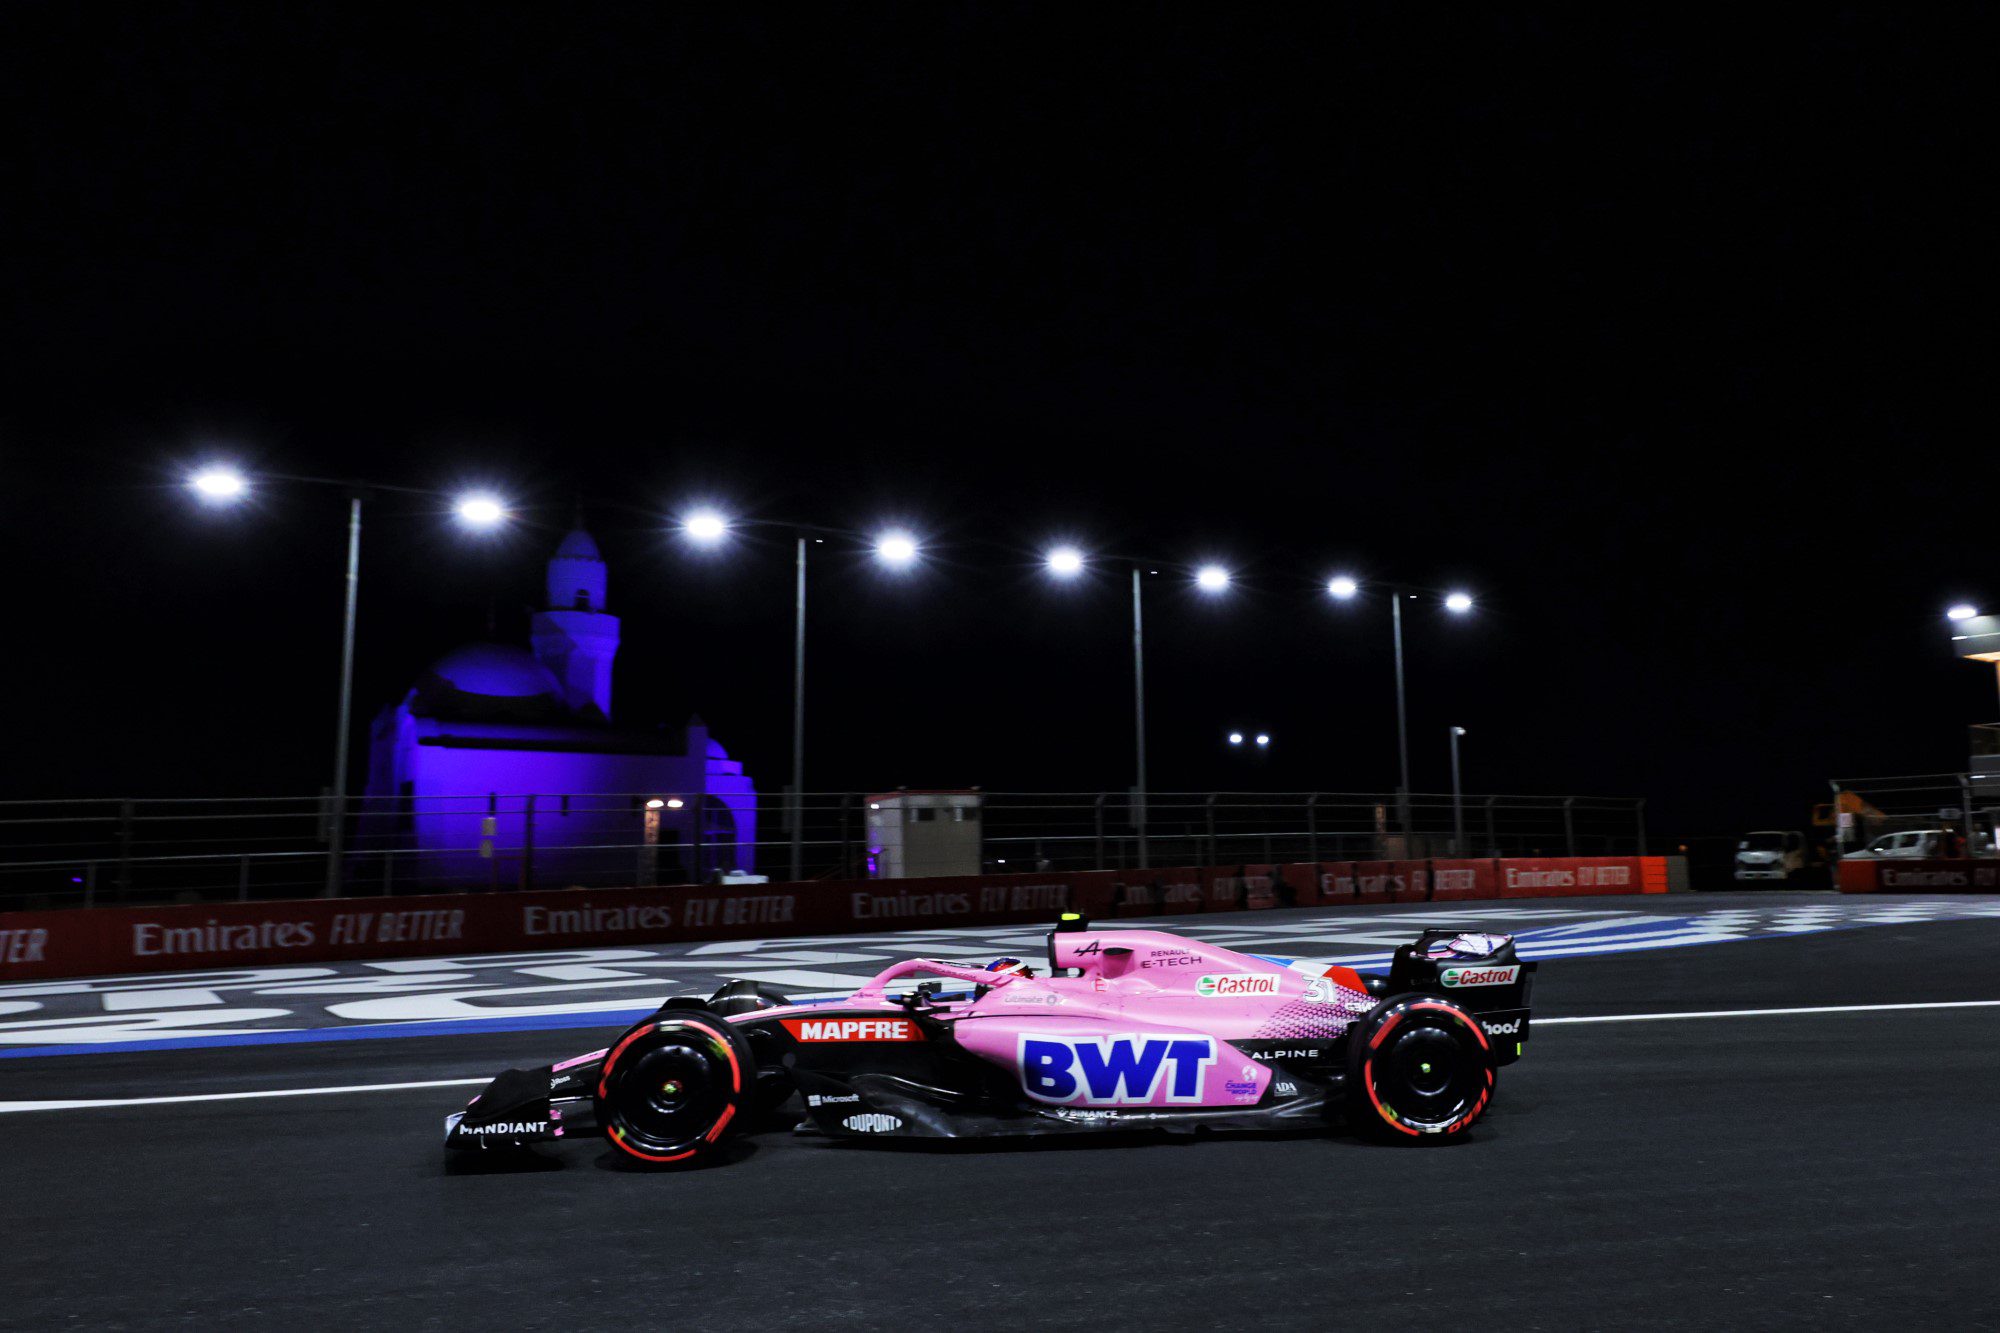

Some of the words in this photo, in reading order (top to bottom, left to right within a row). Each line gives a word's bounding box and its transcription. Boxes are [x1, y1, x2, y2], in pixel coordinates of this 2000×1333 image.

[850, 889, 972, 919] Emirates
[522, 902, 672, 936] Emirates
[682, 898, 719, 928] FLY
[722, 895, 796, 925] BETTER
[132, 919, 316, 957] Emirates
[328, 913, 374, 945] FLY
[376, 909, 465, 943] BETTER
[0, 928, 48, 964] TER
[1150, 948, 1190, 958] RENAULT
[1141, 956, 1202, 969] E-TECH
[1216, 975, 1275, 995] Castrol
[1459, 968, 1514, 986] Castrol
[1303, 975, 1338, 1004] 31
[800, 1021, 909, 1040] MAPFRE
[1481, 1018, 1522, 1035] hoo!
[1251, 1049, 1320, 1060] ALPINE
[1020, 1036, 1213, 1101] BWT
[821, 1093, 860, 1104] Microsoft
[847, 1112, 898, 1132] DUPONT
[1069, 1109, 1117, 1119] BINANCE
[459, 1121, 548, 1135] MANDIANT
